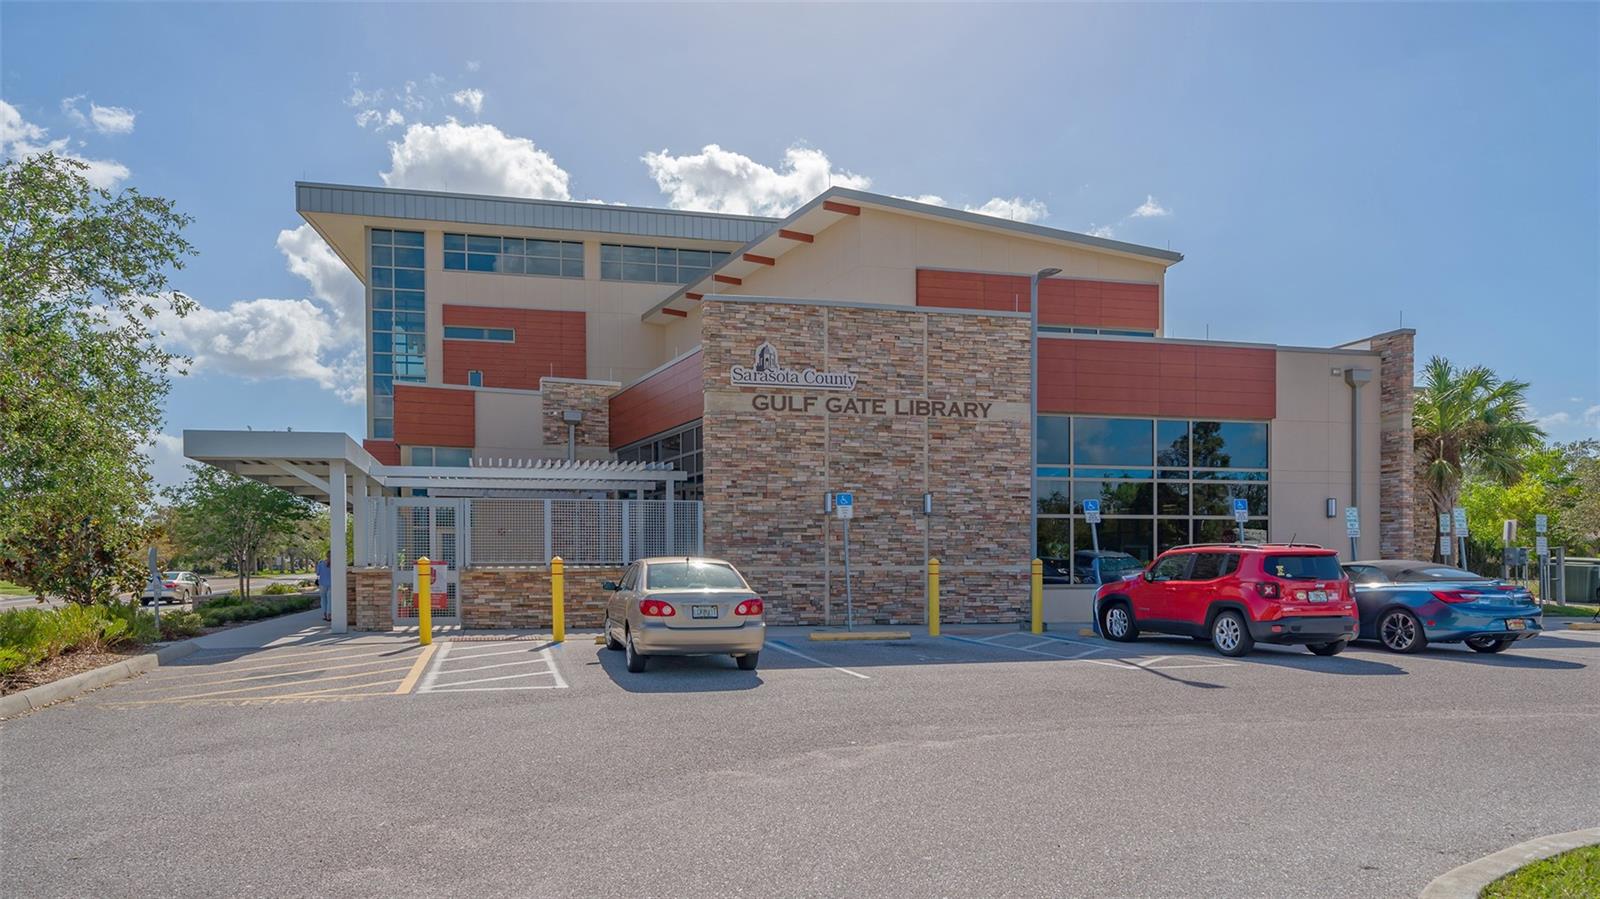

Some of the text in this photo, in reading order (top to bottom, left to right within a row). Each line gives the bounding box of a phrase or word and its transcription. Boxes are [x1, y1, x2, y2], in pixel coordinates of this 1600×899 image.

[732, 367, 857, 389] Sarasota County
[752, 394, 992, 418] GULF GATE LIBRARY
